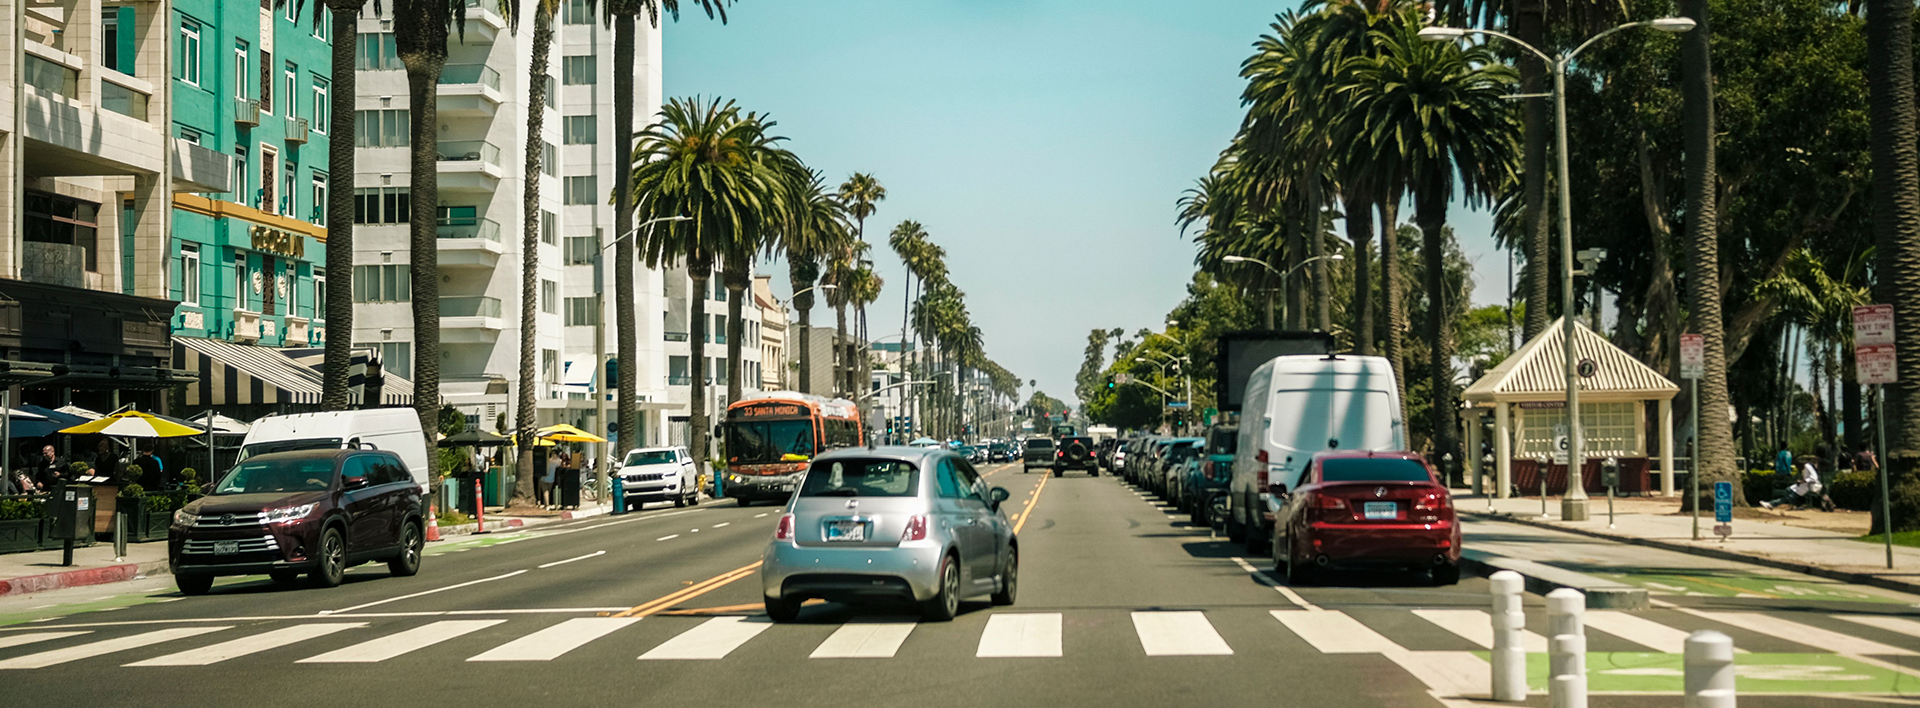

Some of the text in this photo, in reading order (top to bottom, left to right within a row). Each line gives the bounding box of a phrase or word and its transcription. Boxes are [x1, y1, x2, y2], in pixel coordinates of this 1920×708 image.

[1857, 322, 1891, 331] ANY TIME
[744, 406, 798, 416] 33 SANTA MONICA
